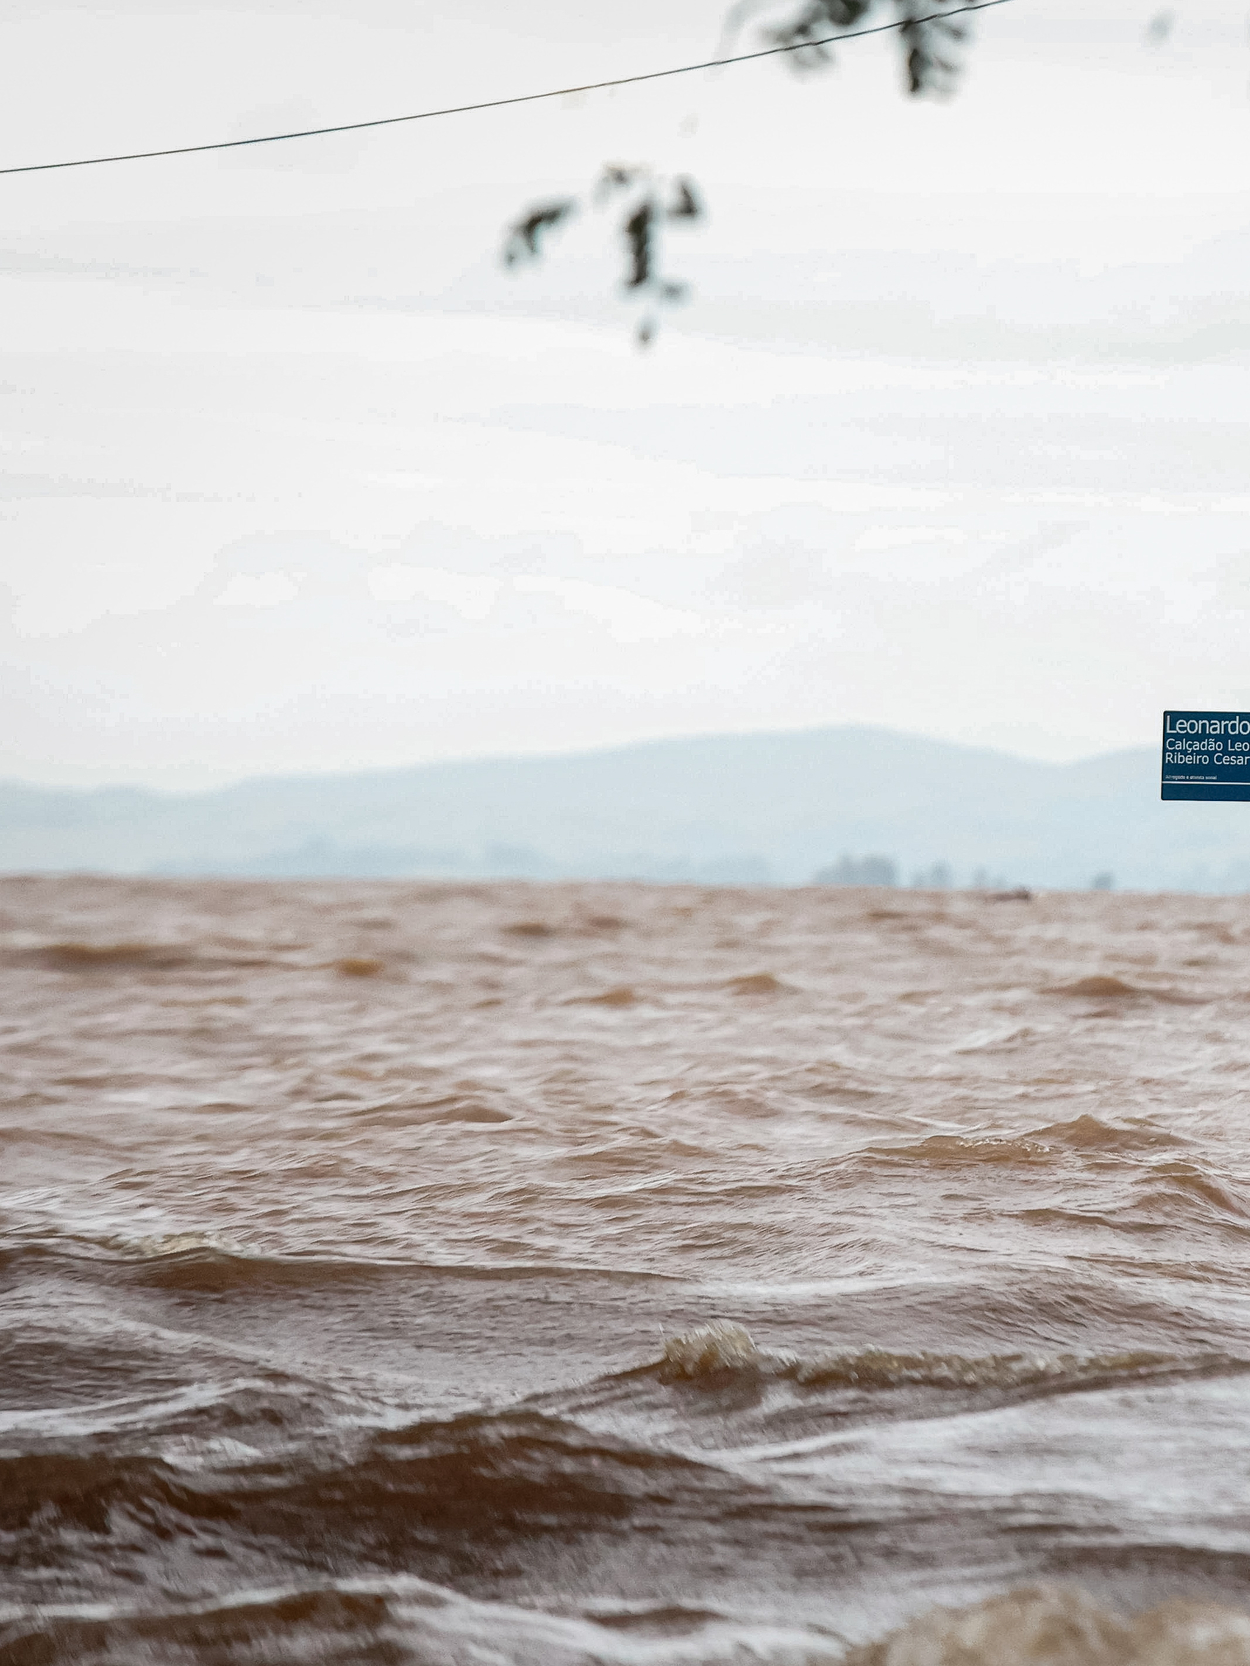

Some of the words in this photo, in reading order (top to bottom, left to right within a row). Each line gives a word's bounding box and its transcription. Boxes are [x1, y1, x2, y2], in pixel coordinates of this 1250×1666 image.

[1166, 715, 1250, 735] Leonardo
[1166, 738, 1224, 753] Calçadão
[1165, 752, 1210, 765] Ribeiro
[1213, 753, 1250, 766] Cesar
